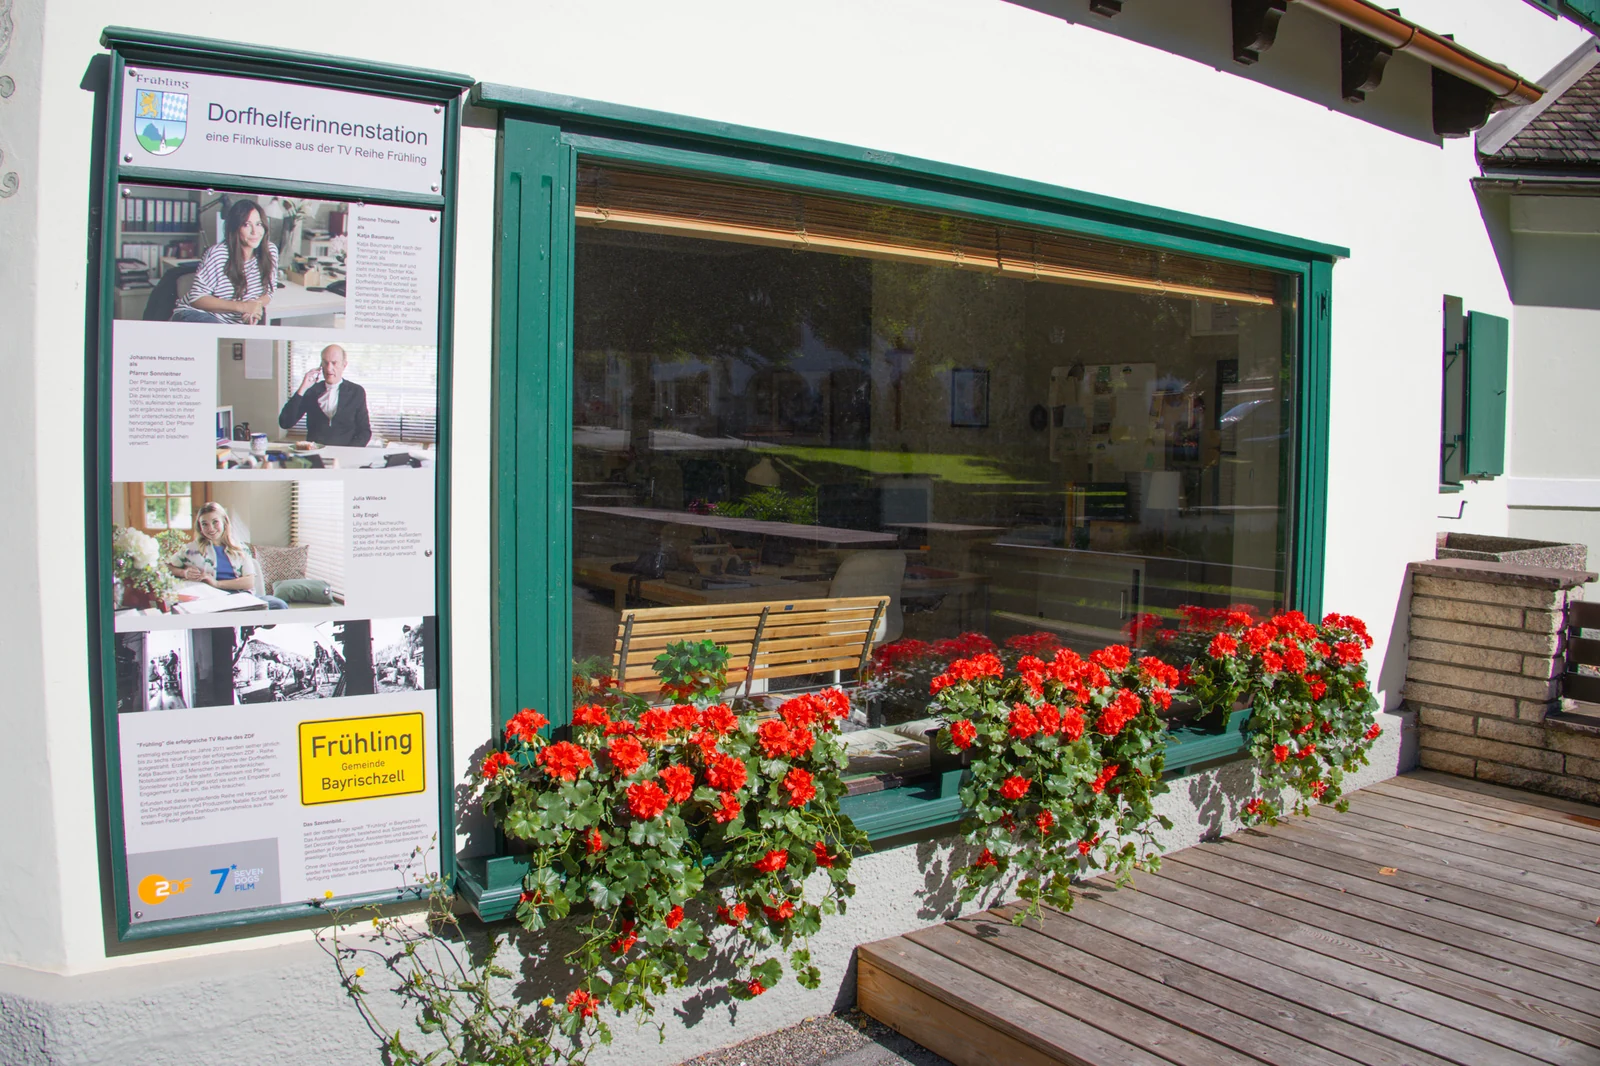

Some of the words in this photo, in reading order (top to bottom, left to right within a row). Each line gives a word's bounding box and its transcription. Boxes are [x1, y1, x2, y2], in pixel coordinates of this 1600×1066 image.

[208, 102, 428, 146] Dorfhelferinnenstation
[206, 132, 230, 143] eine
[232, 134, 292, 150] Filmkulisse
[295, 142, 314, 152] aus
[317, 144, 334, 154] der
[337, 145, 352, 156] TV
[355, 147, 384, 160] Reihe
[388, 150, 427, 167] Frühling
[176, 737, 207, 746] erfolgreiche
[312, 730, 412, 758] Frühling
[342, 760, 385, 771] Gemeinde
[322, 770, 404, 792] Bayrischzell
[234, 868, 264, 878] SEVEN
[234, 875, 260, 885] DOGS
[234, 883, 255, 892] FILM
